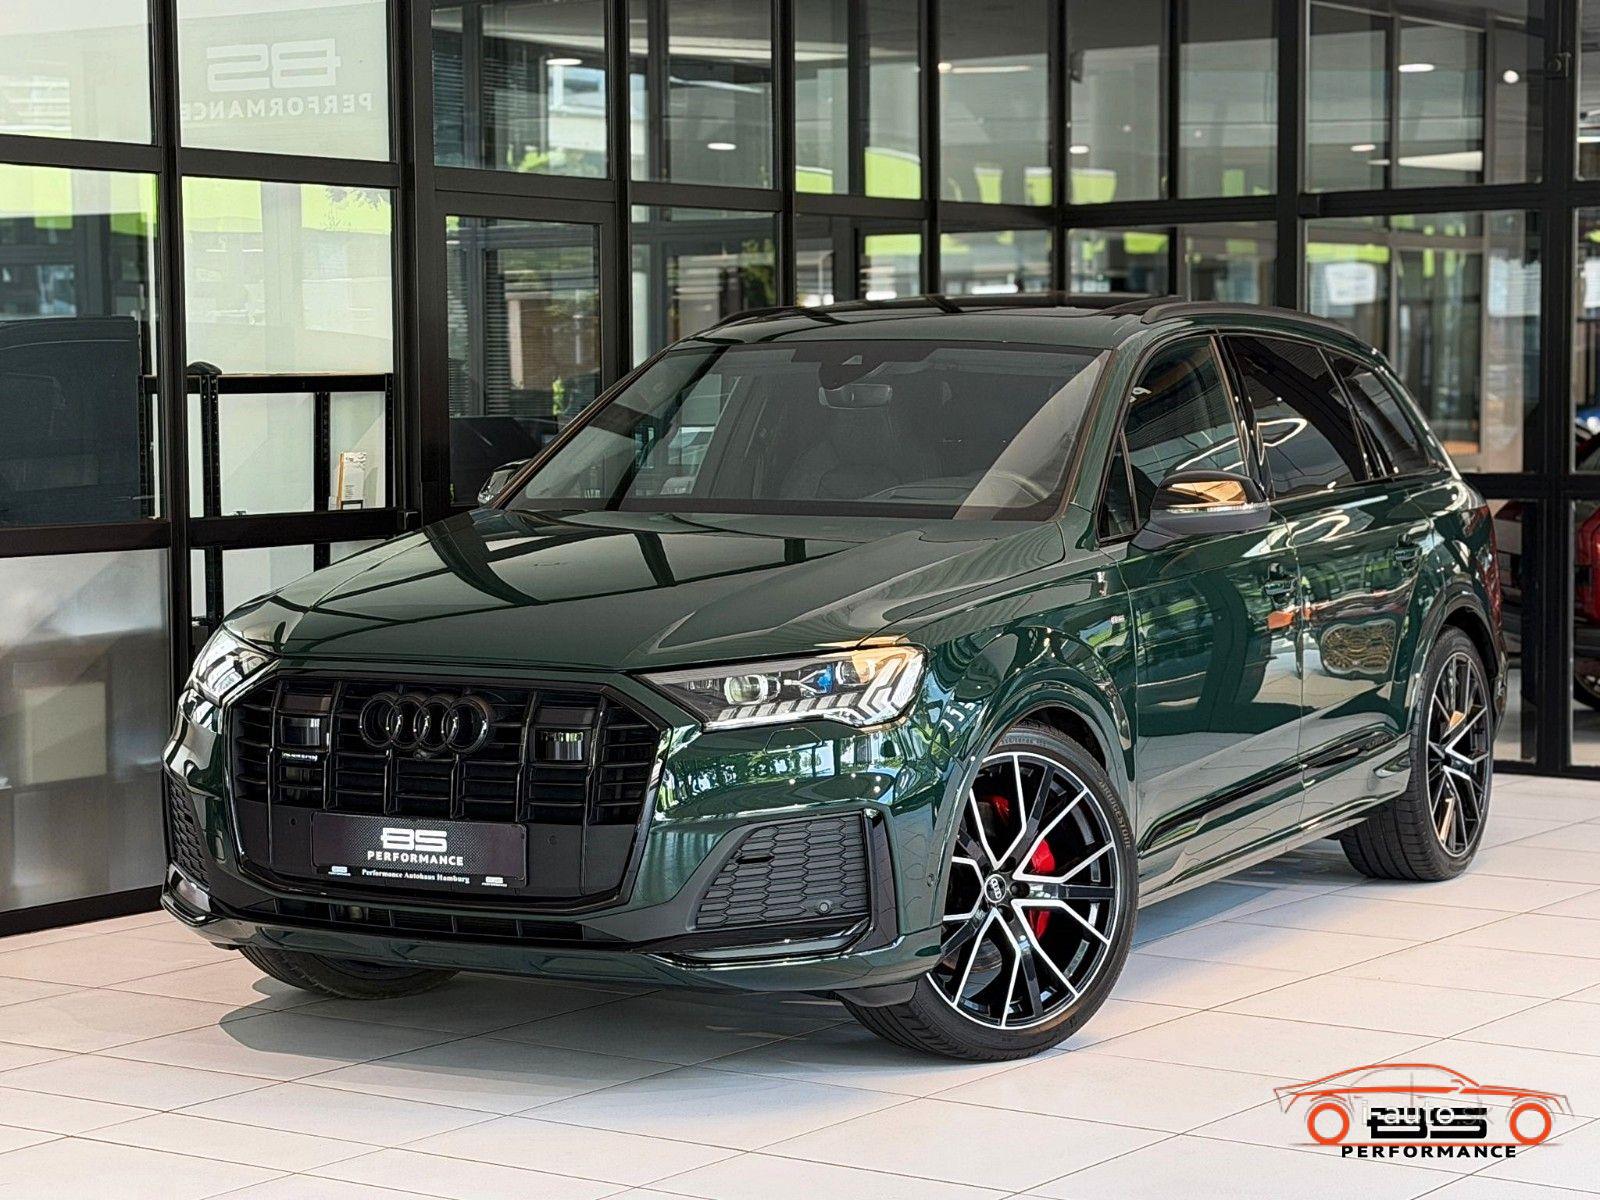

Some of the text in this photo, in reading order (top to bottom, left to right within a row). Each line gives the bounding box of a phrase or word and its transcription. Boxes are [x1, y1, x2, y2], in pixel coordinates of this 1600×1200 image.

[367, 850, 464, 866] PERFORMANCE
[362, 868, 470, 884] Performance Autohaus Hamburg
